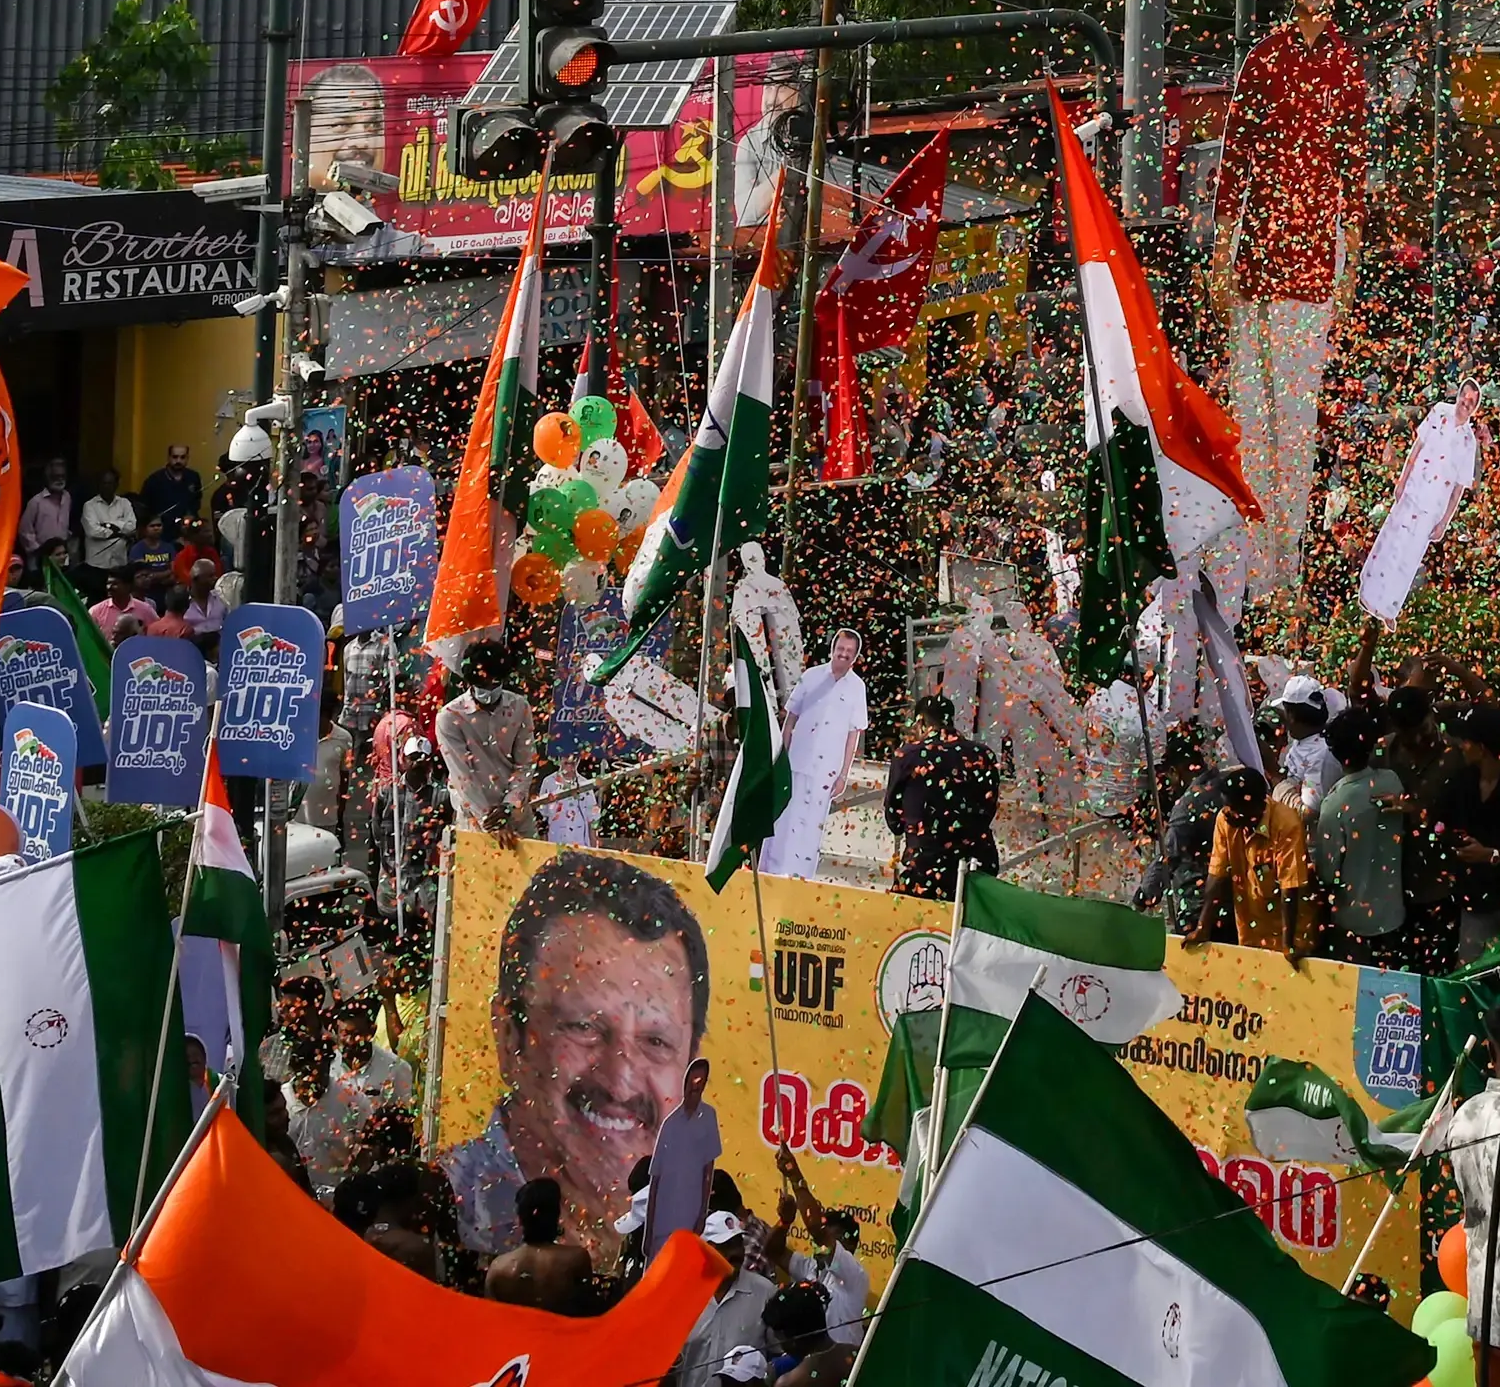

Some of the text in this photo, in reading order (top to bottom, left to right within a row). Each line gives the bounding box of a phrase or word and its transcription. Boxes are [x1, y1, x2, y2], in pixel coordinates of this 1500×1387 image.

[63, 260, 258, 302] RESTAURAN
[349, 534, 429, 587] UDF
[347, 573, 417, 603] നയിക്കും
[233, 647, 306, 668] കേരളം
[126, 678, 195, 696] കേരളം
[224, 682, 311, 726] UDF
[119, 708, 202, 754] UDF
[221, 724, 296, 751] നയിക്കും
[11, 751, 63, 778] കേരളം
[115, 753, 187, 776] നയിക്കും
[5, 788, 69, 843] UDF
[774, 920, 848, 941] വട്ടിയൂർക്കാവ്
[773, 949, 845, 1012] UDF
